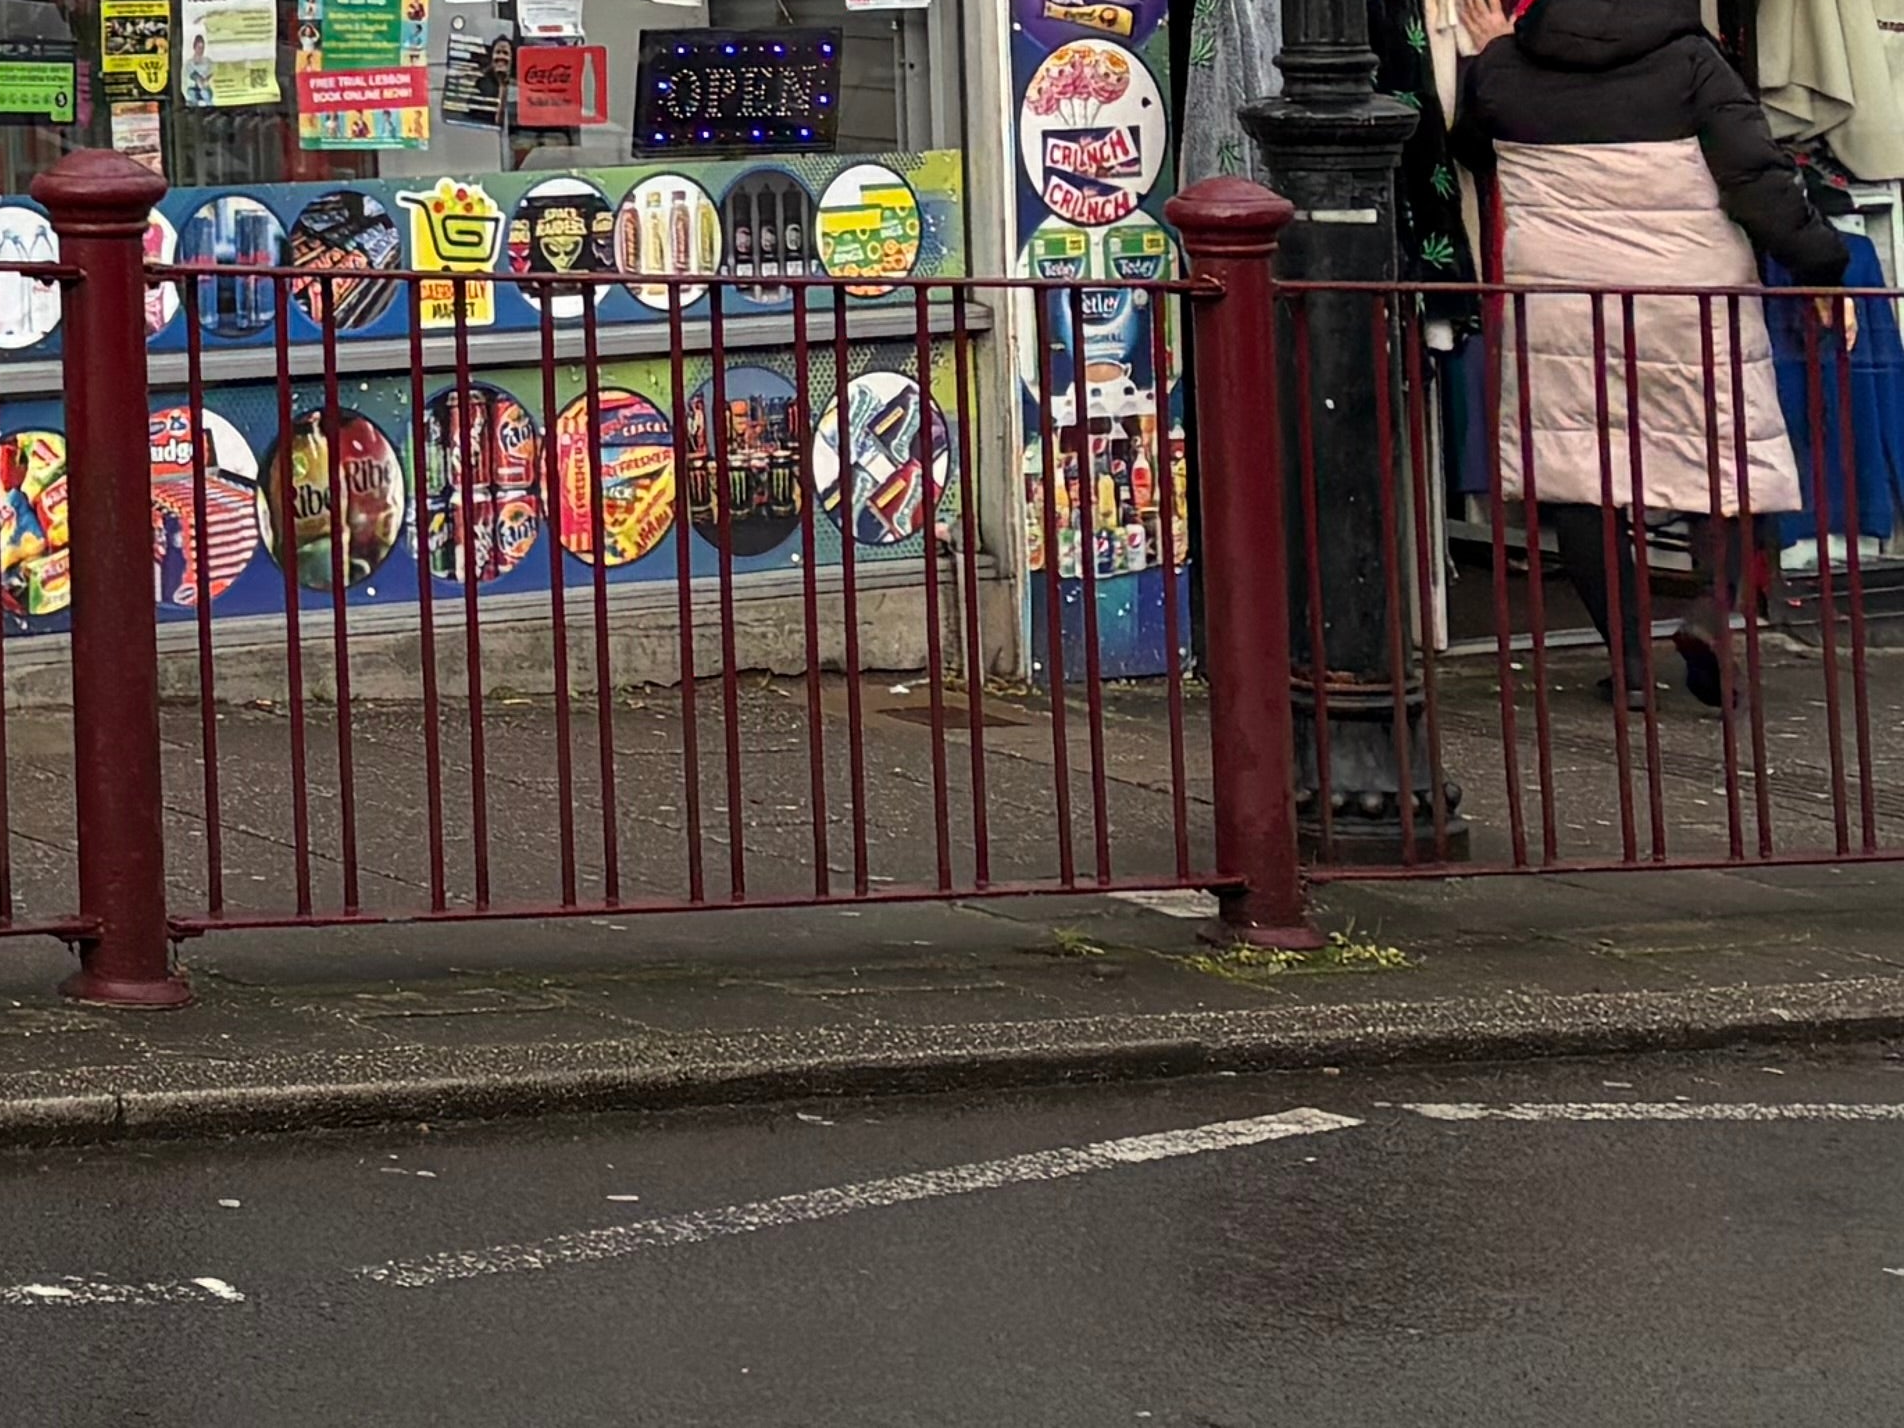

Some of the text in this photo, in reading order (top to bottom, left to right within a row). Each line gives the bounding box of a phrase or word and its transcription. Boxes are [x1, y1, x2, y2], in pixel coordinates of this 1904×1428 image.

[310, 73, 412, 90] FREE TRIAL LESSON
[312, 90, 342, 104] BOOK
[342, 89, 381, 101] ONLINE
[665, 65, 819, 120] OPEN
[1048, 128, 1130, 170] CRUNCH
[1048, 182, 1132, 223] CRUNCH
